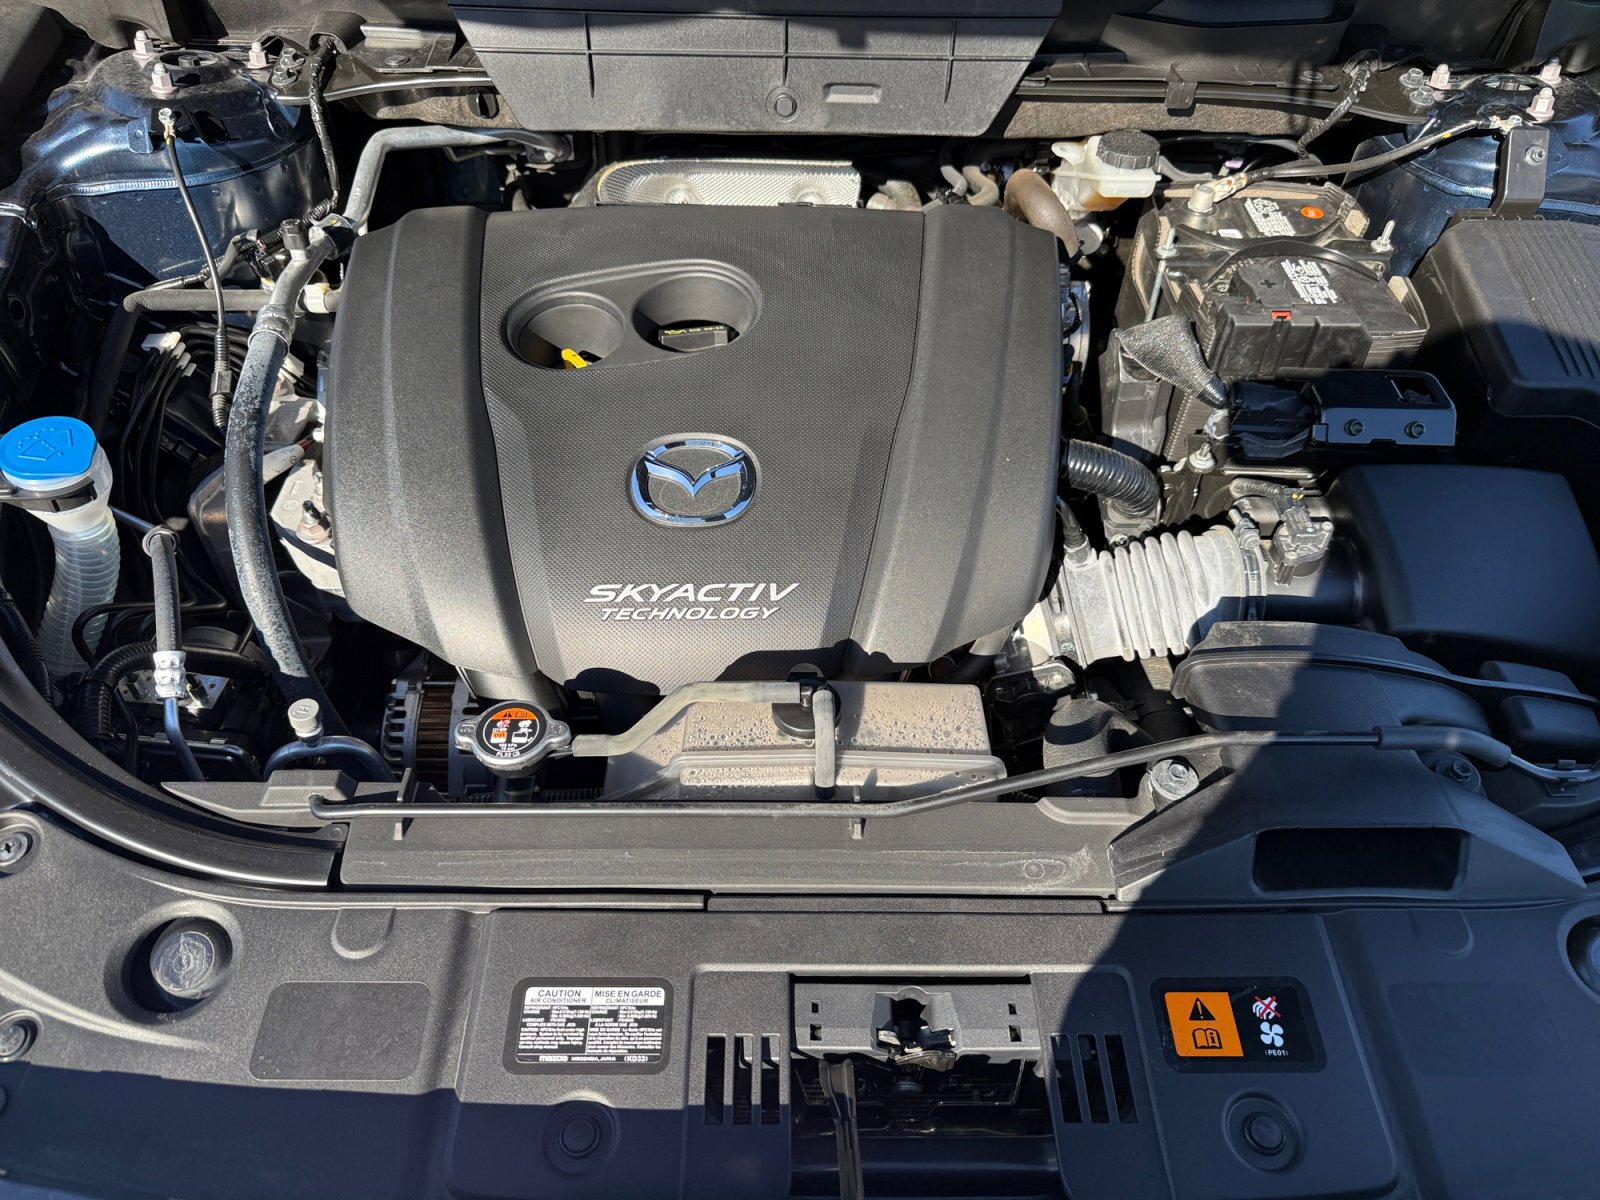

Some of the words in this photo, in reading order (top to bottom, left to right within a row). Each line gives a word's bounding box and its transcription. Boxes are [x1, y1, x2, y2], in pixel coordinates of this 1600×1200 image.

[583, 582, 801, 603] SKYACTIV
[600, 606, 780, 621] TECHNOLOGY
[538, 989, 582, 998] CAUTION
[595, 990, 616, 998] MISE
[618, 990, 630, 998] EN
[631, 990, 662, 998] GARDE
